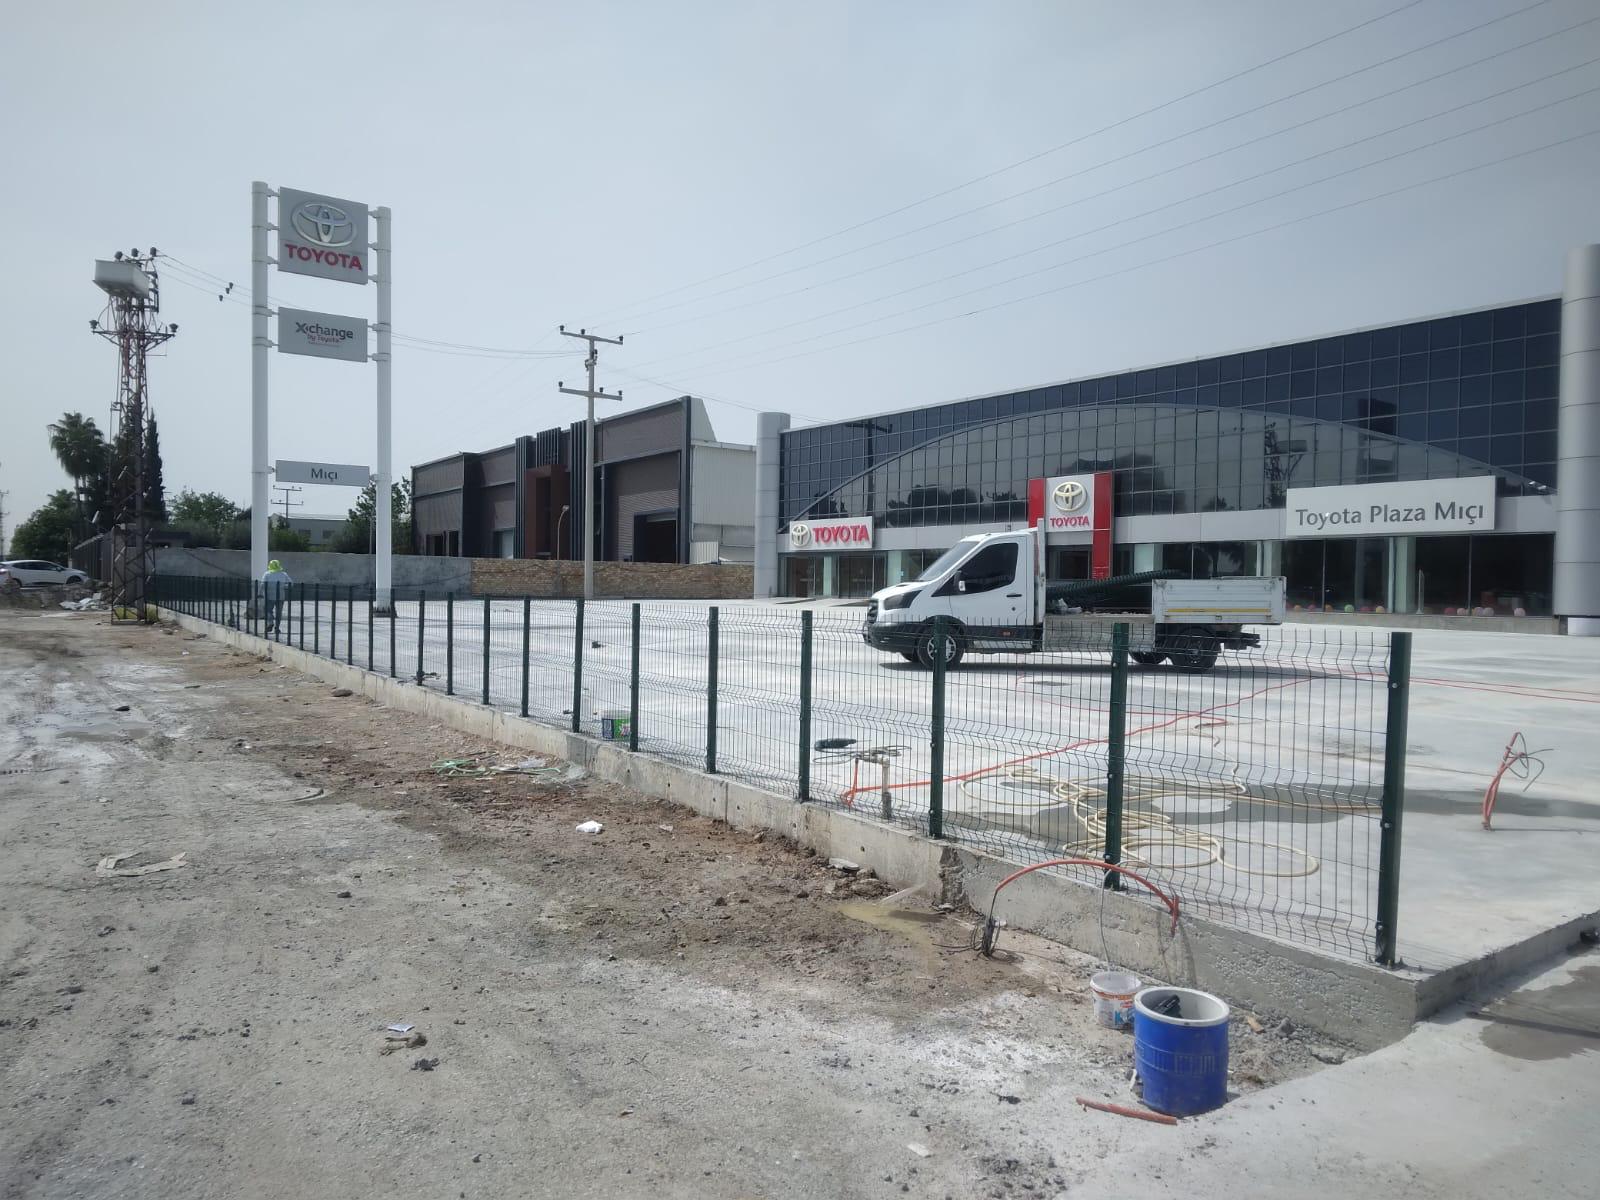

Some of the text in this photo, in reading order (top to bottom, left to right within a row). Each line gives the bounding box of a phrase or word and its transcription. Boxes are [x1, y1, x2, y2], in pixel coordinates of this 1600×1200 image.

[285, 244, 362, 271] TOYOTA
[1049, 515, 1090, 528] TOYOTA
[1295, 508, 1362, 530] Toyota
[1370, 504, 1426, 523] Plaza
[812, 524, 870, 544] TOYOTA
